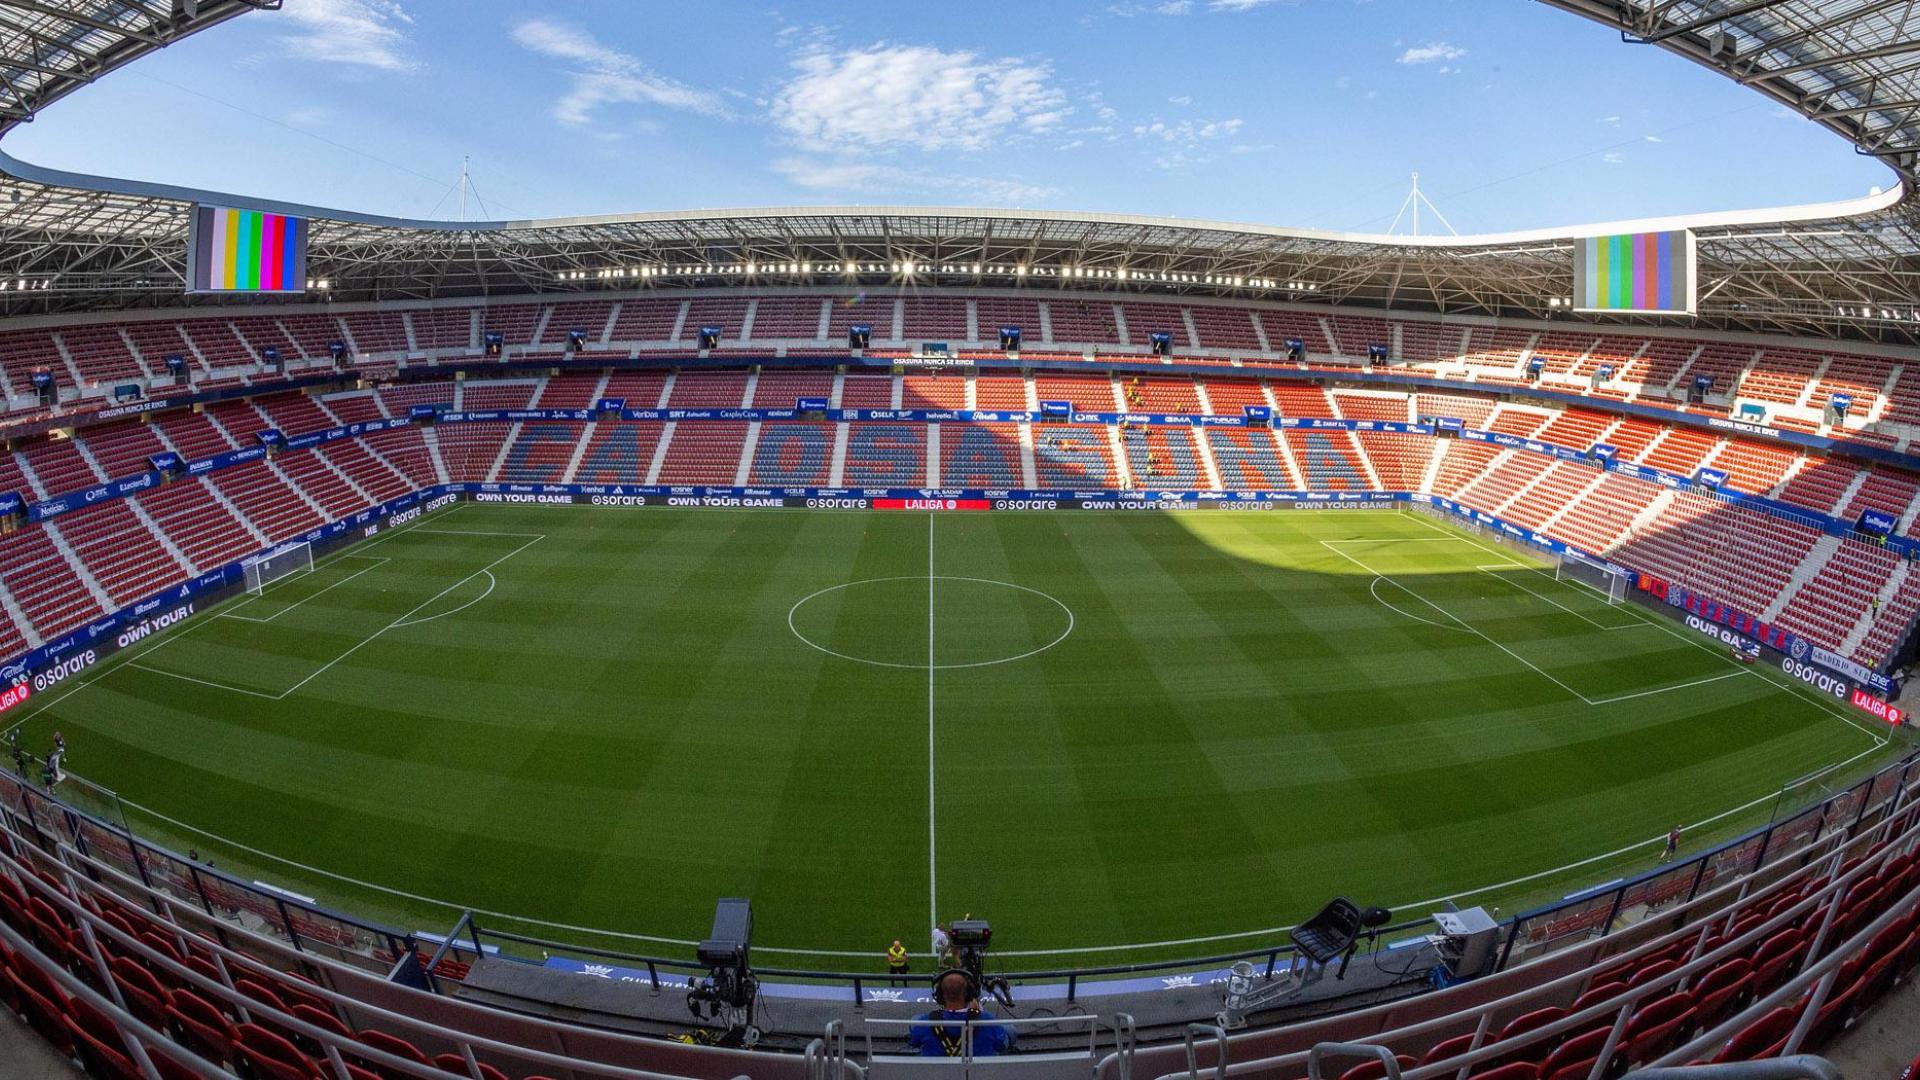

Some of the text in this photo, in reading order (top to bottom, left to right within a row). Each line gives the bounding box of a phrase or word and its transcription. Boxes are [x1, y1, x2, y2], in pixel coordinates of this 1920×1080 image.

[99, 407, 125, 419] OSASUNA
[125, 404, 144, 414] NUNCA
[926, 412, 952, 420] helvetia
[476, 493, 572, 503] OWN YOUR GAME
[602, 495, 646, 506] sorare
[668, 497, 784, 507] OWN YOUR GAME
[818, 498, 867, 508] sorare
[905, 499, 944, 509] LALIGA
[1008, 500, 1057, 510] sorare
[1082, 501, 1198, 510] OWN YOUR GAME
[1230, 500, 1273, 510] sorare
[1294, 501, 1393, 510] OWN YOUR GAME
[365, 525, 378, 537] ME
[118, 622, 151, 648] OWN
[153, 607, 188, 631] YOUR
[1720, 630, 1761, 658] GAE
[47, 649, 96, 686] sorare
[1794, 663, 1846, 698] sorare
[1854, 692, 1887, 718] LALIGA
